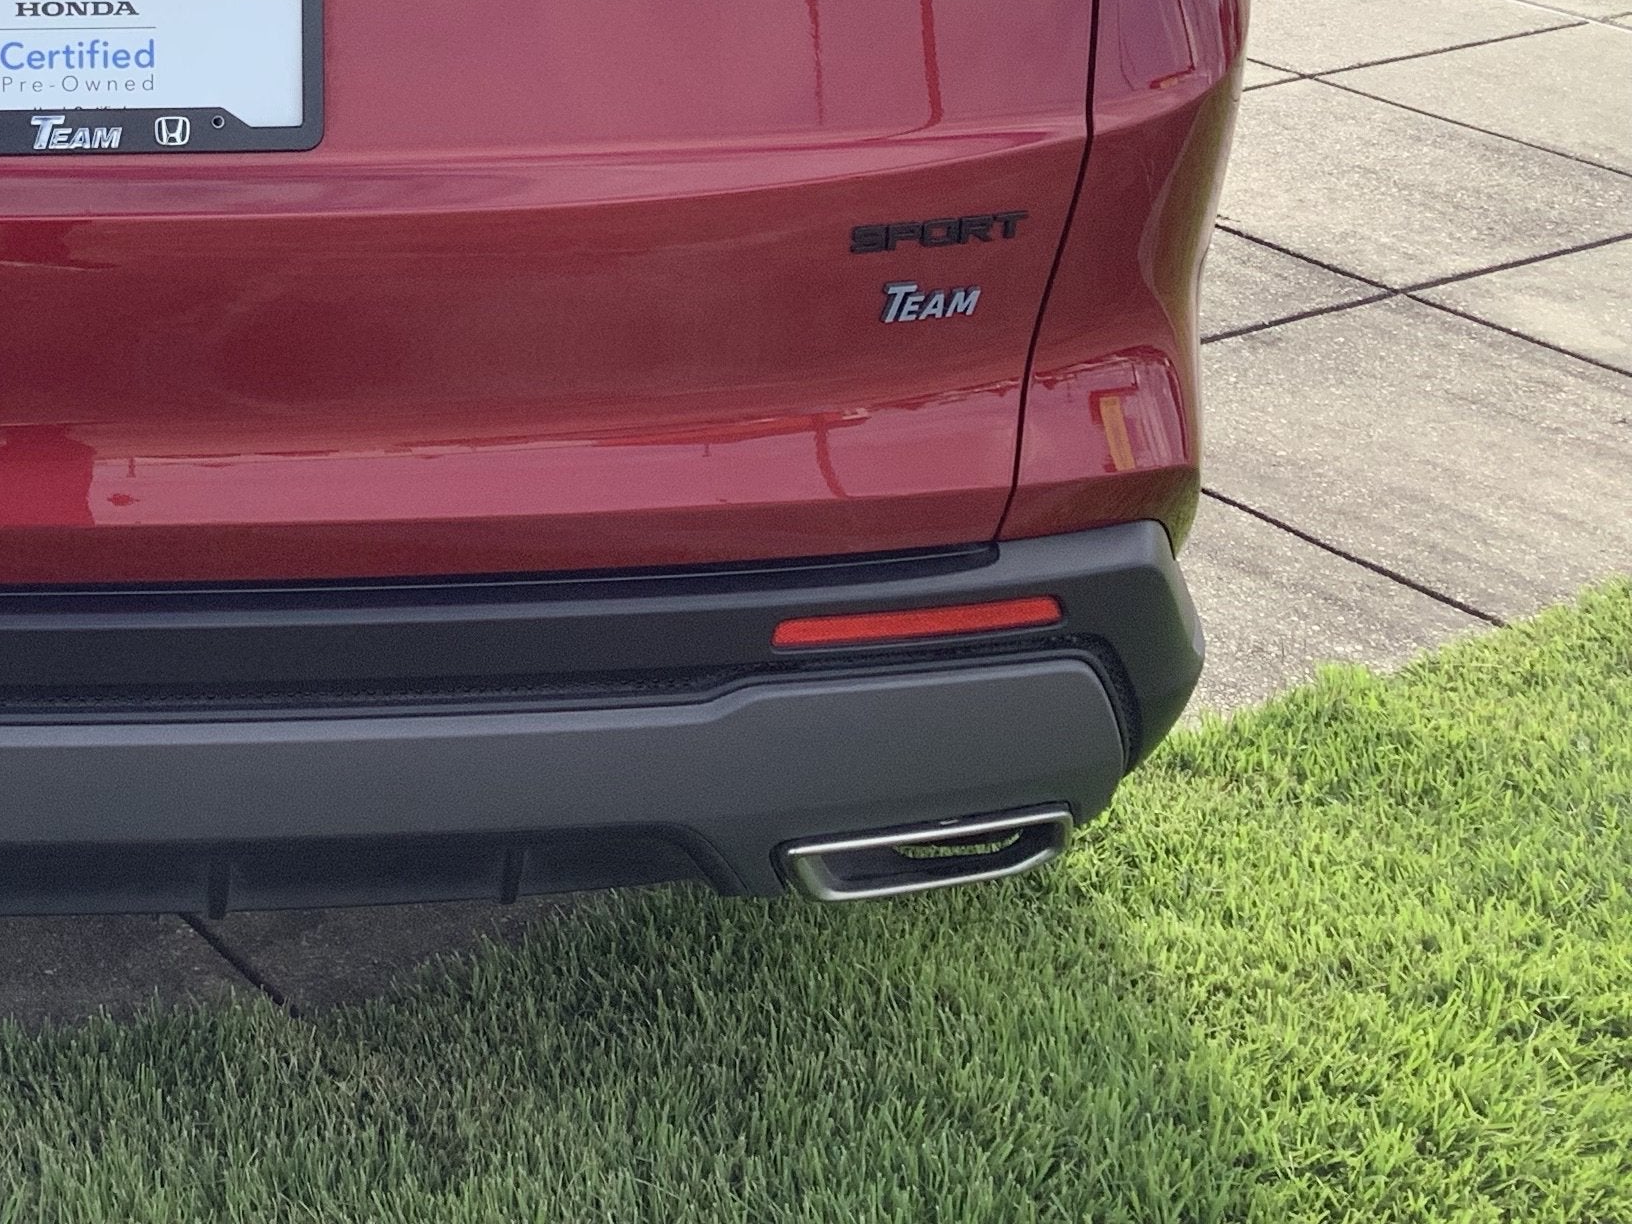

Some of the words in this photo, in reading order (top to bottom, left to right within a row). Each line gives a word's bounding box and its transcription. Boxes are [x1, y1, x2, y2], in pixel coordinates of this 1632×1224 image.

[15, 1, 140, 17] HONDA
[0, 38, 156, 70] Certified
[2, 73, 155, 92] Pre-Owned
[30, 115, 123, 150] TEAM
[849, 210, 1029, 254] SPORT
[881, 280, 981, 323] TEAM
